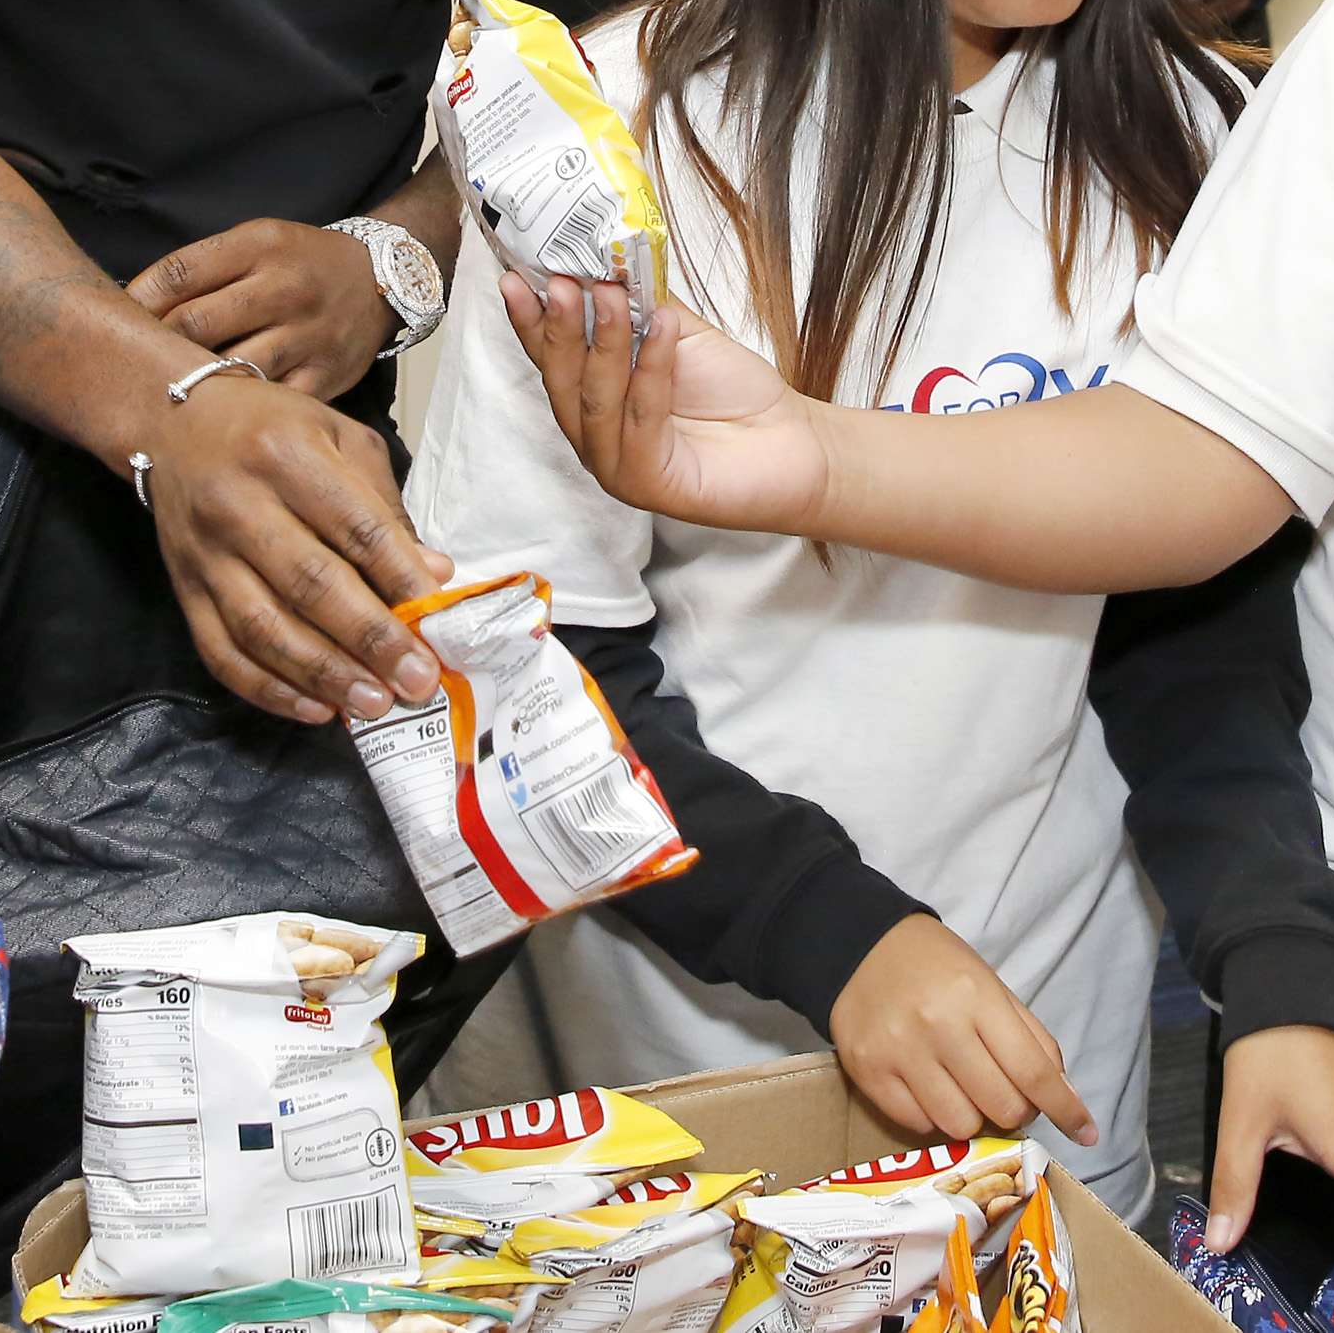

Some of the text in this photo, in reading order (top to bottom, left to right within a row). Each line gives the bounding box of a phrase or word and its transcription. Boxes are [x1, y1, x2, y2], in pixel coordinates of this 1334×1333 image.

[474, 96, 501, 119] farm-grown
[500, 80, 522, 99] potatoes
[487, 118, 502, 133] potato
[501, 111, 513, 123] chip
[516, 92, 537, 110] perfectly
[473, 115, 493, 133] seasoned
[493, 129, 505, 141] fresh
[505, 117, 519, 131] potato
[491, 140, 505, 153] Every
[560, 153, 582, 175] G F
[521, 172, 550, 207] preservatives
[382, 726, 406, 740] serving
[416, 717, 447, 741] 160
[410, 748, 428, 761] Daily
[156, 986, 191, 1005] 160
[155, 1014, 170, 1022] Daily
[178, 1035, 190, 1043] 7%
[179, 1055, 192, 1064] 0%
[181, 1066, 194, 1074] 7%
[93, 1076, 195, 1089] Carbohydrate 15g 6%
[304, 1073, 317, 1083] Every
[182, 1087, 195, 1096] 5%
[128, 1100, 144, 1108] than
[145, 1100, 154, 1109] 1g
[304, 1130, 363, 1154] No artificial flavors
[369, 1138, 392, 1158] G F
[304, 1144, 360, 1164] No preservatives
[369, 1164, 401, 1182] GLUTEN FREE
[146, 1181, 154, 1191] of
[154, 1181, 175, 1191] added
[164, 1222, 174, 1230] Oil
[136, 1232, 149, 1240] and
[795, 1251, 821, 1269] Serving
[785, 1273, 839, 1293] Calories
[615, 1294, 631, 1303] 13%
[875, 1292, 891, 1301] 13%
[617, 1304, 629, 1313] 7%
